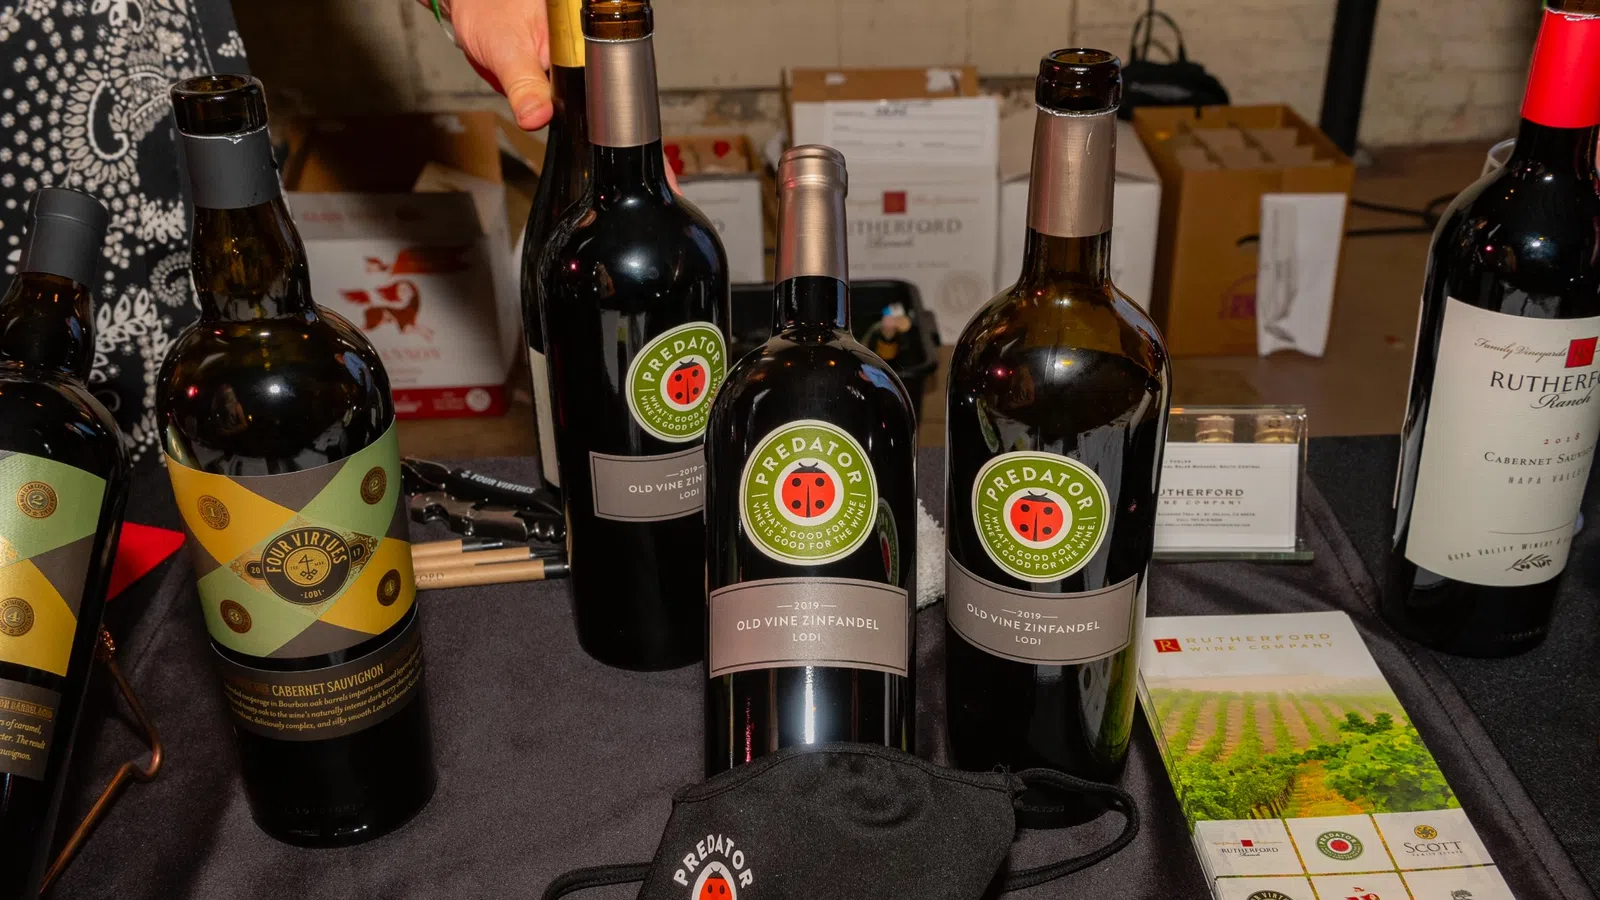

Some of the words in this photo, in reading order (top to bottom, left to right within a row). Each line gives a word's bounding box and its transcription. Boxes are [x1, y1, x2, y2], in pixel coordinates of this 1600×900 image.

[642, 336, 720, 382] PREDATOR
[1474, 337, 1517, 360] Family
[1514, 345, 1568, 363] Vineyards
[1490, 370, 1600, 392] RUTHERF
[1530, 383, 1600, 409] Ranch
[641, 395, 654, 416] VINE
[652, 415, 662, 424] IS
[662, 421, 688, 431] GOOD
[690, 416, 705, 429] FOR
[650, 395, 673, 420] WHAT'S
[675, 412, 699, 423] GOOD
[1544, 432, 1580, 445] 2018
[755, 437, 862, 486] PREDATOR
[1484, 451, 1552, 466] CABERNET
[679, 466, 698, 477] 2019
[1508, 476, 1541, 484] NAPA
[471, 474, 496, 486] FOUR
[496, 481, 535, 494] VIRTUES
[628, 485, 653, 493] OLD
[656, 480, 683, 492] VINE
[686, 473, 704, 486] ZIN
[986, 466, 1093, 510] PREDATOR
[679, 488, 700, 500] LODI
[753, 502, 766, 528] VINE
[764, 526, 774, 537] IS
[774, 535, 805, 550] GOOD
[810, 540, 832, 550] FOR
[833, 528, 853, 544] THE
[850, 500, 867, 529] WINE.
[762, 501, 788, 534] WHAT'S
[790, 530, 823, 540] GOOD
[826, 519, 847, 536] FOR
[843, 500, 857, 519] THE
[984, 512, 996, 537] VINE
[993, 539, 1002, 549] IS
[1002, 550, 1031, 569] GOOD
[1035, 561, 1057, 570] FOR
[1059, 551, 1079, 565] THE
[1077, 521, 1096, 549] WINE.
[992, 516, 1016, 551] WHAT'S
[1017, 550, 1049, 561] GOOD
[1052, 543, 1073, 559] FOR
[1071, 525, 1085, 543] THE
[266, 540, 293, 573] FOUR
[291, 531, 347, 564] VIRTUES
[250, 566, 261, 574] 20
[304, 589, 323, 599] LODI
[794, 601, 820, 610] 2019
[1018, 610, 1041, 619] 2019
[737, 619, 760, 631] OLD
[764, 616, 798, 627] VINE
[802, 616, 879, 631] ZINFANDEL
[967, 603, 988, 619] OLD
[990, 614, 1021, 630] VINE
[1024, 621, 1100, 634] ZINFANDEL
[792, 633, 821, 642] LODI
[1015, 635, 1041, 645] LODI
[1160, 640, 1178, 652] R
[1186, 633, 1331, 644] RUTHERFORD
[1249, 642, 1334, 651] COMPANY
[272, 682, 325, 697] CABERNET
[326, 663, 385, 693] SAUVIGNON
[258, 709, 270, 717] oak
[277, 710, 289, 718] the
[289, 710, 310, 718] wine's
[311, 705, 343, 716] naturally
[344, 699, 367, 711] intense
[367, 692, 382, 703] dark
[278, 700, 309, 708] Bourbon
[309, 698, 323, 707] oak
[323, 693, 348, 705] barrels
[349, 684, 373, 699] imparts
[5, 718, 16, 730] of
[14, 722, 42, 735] caramel,
[285, 721, 316, 731] complex,
[317, 720, 331, 728] and
[332, 716, 348, 726] silky
[348, 708, 372, 722] smooth
[16, 734, 29, 746] The
[1404, 841, 1462, 853] SCOTT
[673, 834, 753, 889] PREDATOR
